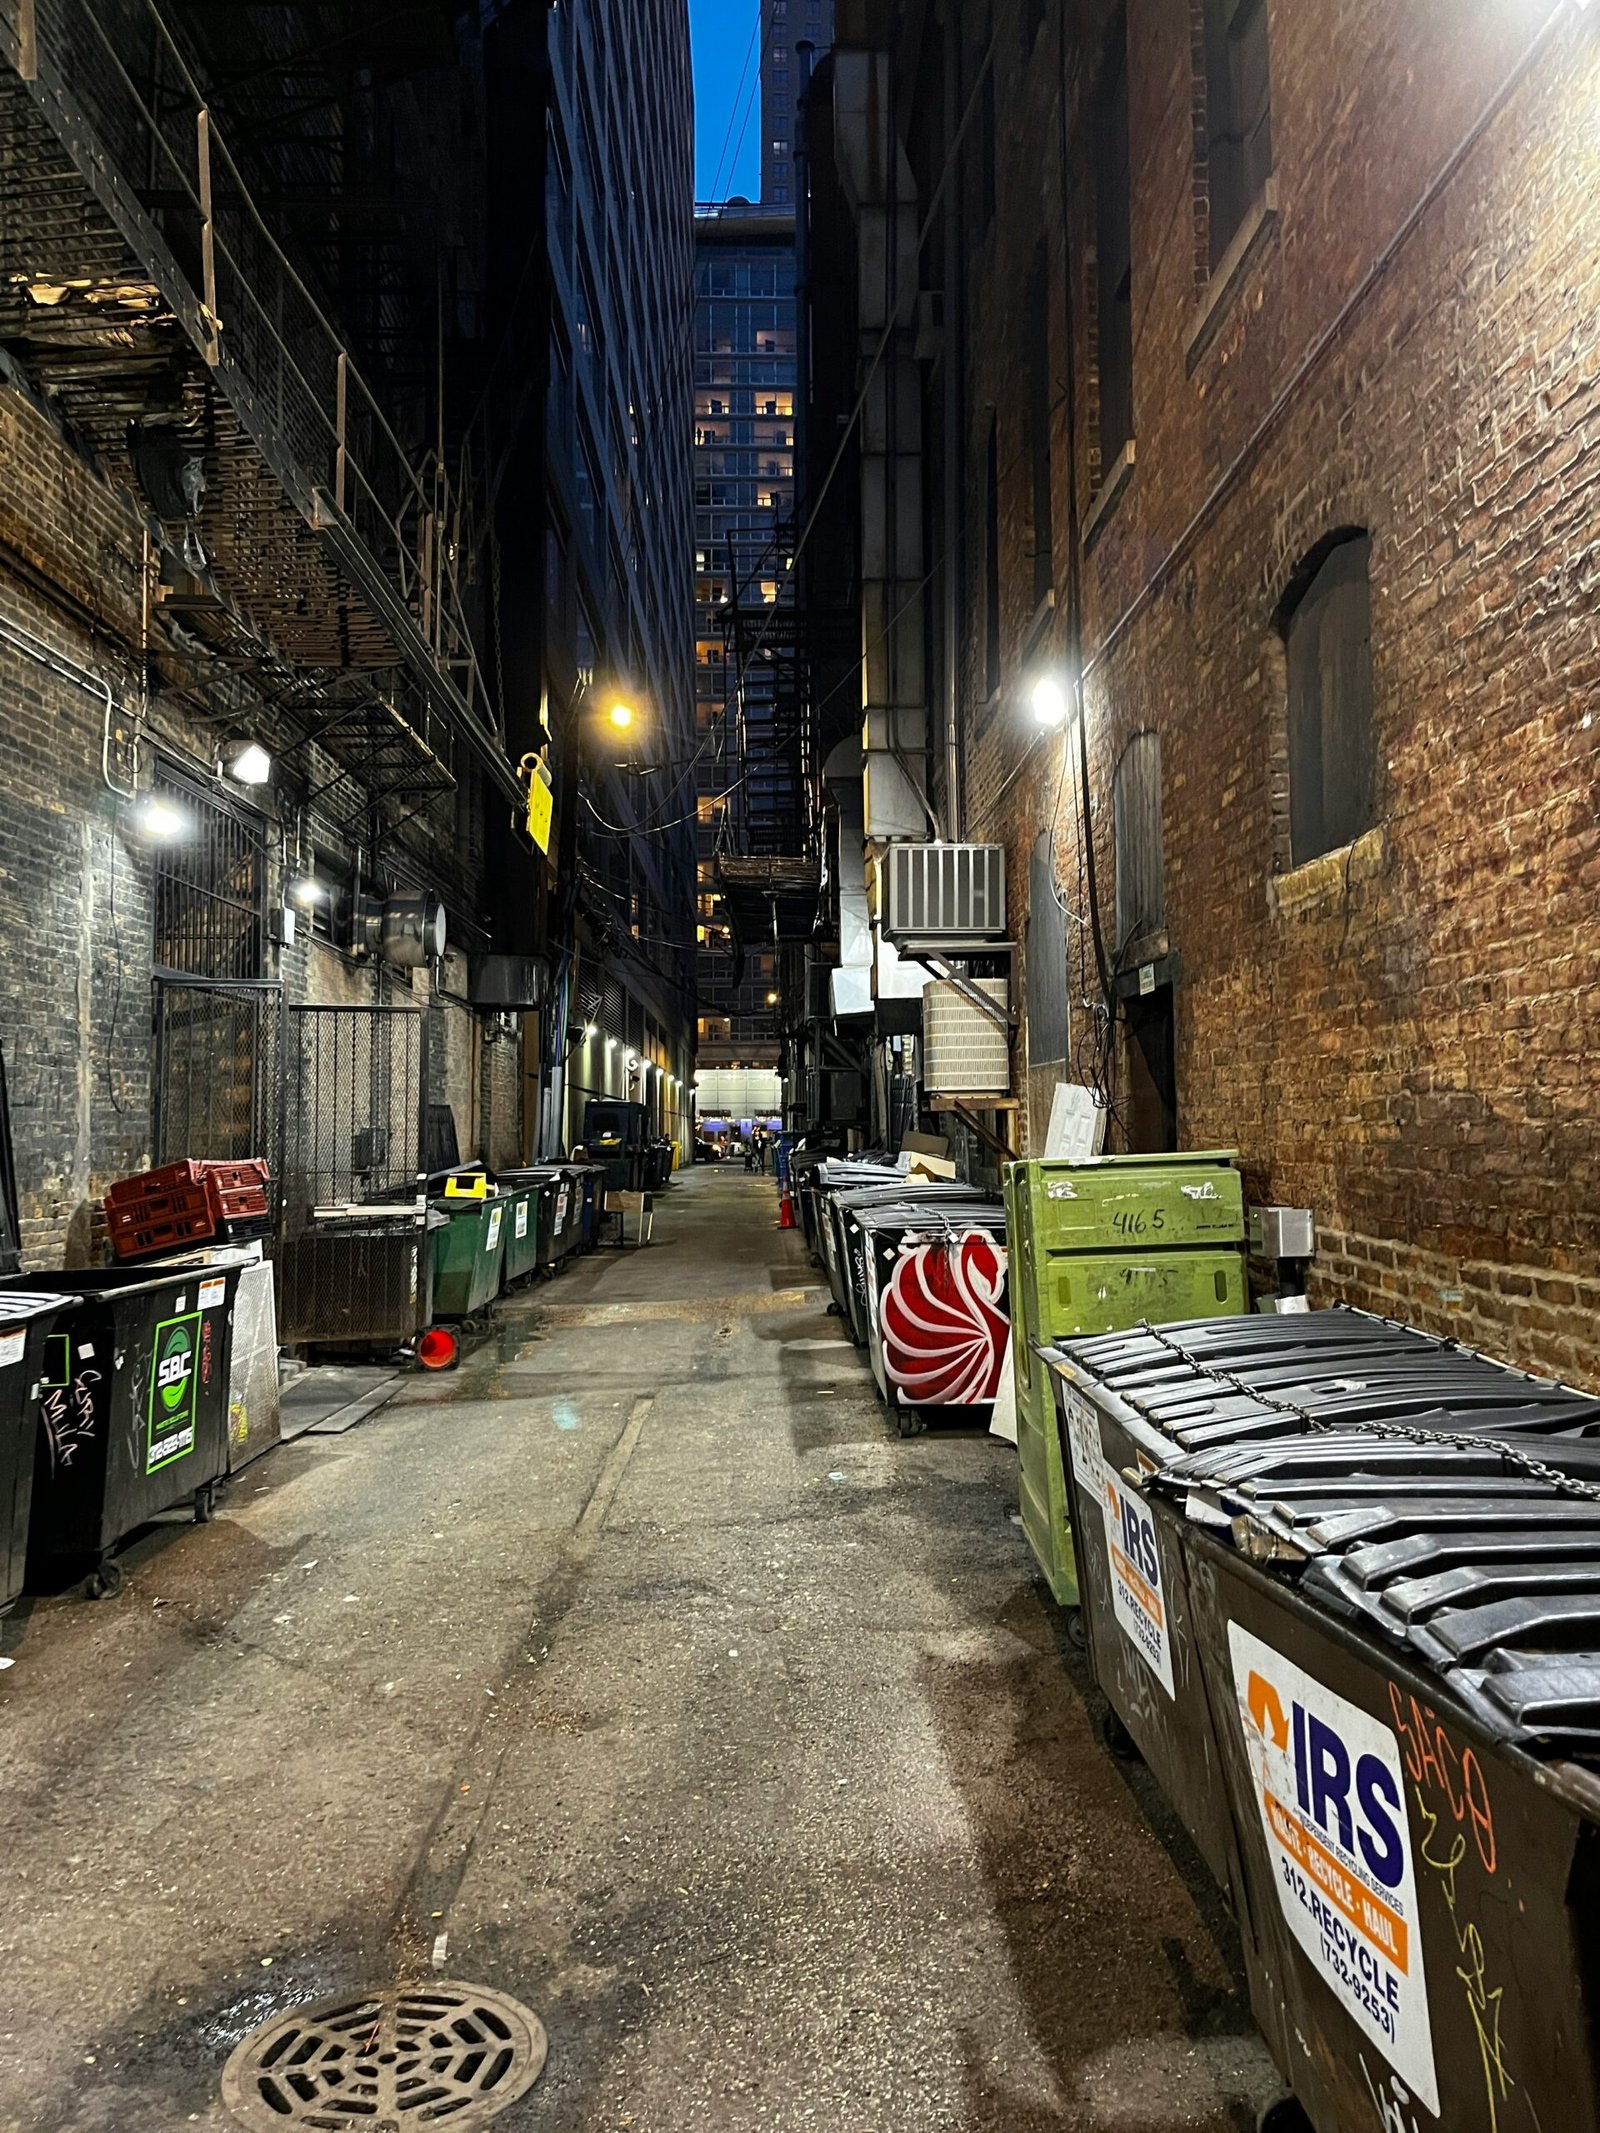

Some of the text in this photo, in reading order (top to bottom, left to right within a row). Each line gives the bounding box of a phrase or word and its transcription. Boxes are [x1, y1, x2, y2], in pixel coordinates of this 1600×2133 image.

[1112, 1208, 1165, 1234] 4165
[157, 1350, 192, 1387] SBC
[1119, 1493, 1158, 1586] IRS
[1292, 1700, 1404, 1888] IRS
[1307, 1843, 1355, 1913] RECYCLE
[1361, 1897, 1399, 1956] HAUL
[1335, 1843, 1370, 1889] RECYCLING
[1370, 1879, 1404, 1916] SERVICES
[1281, 1856, 1400, 2013] 312.RECYCLE
[1320, 1931, 1395, 2044] (732-9253)
